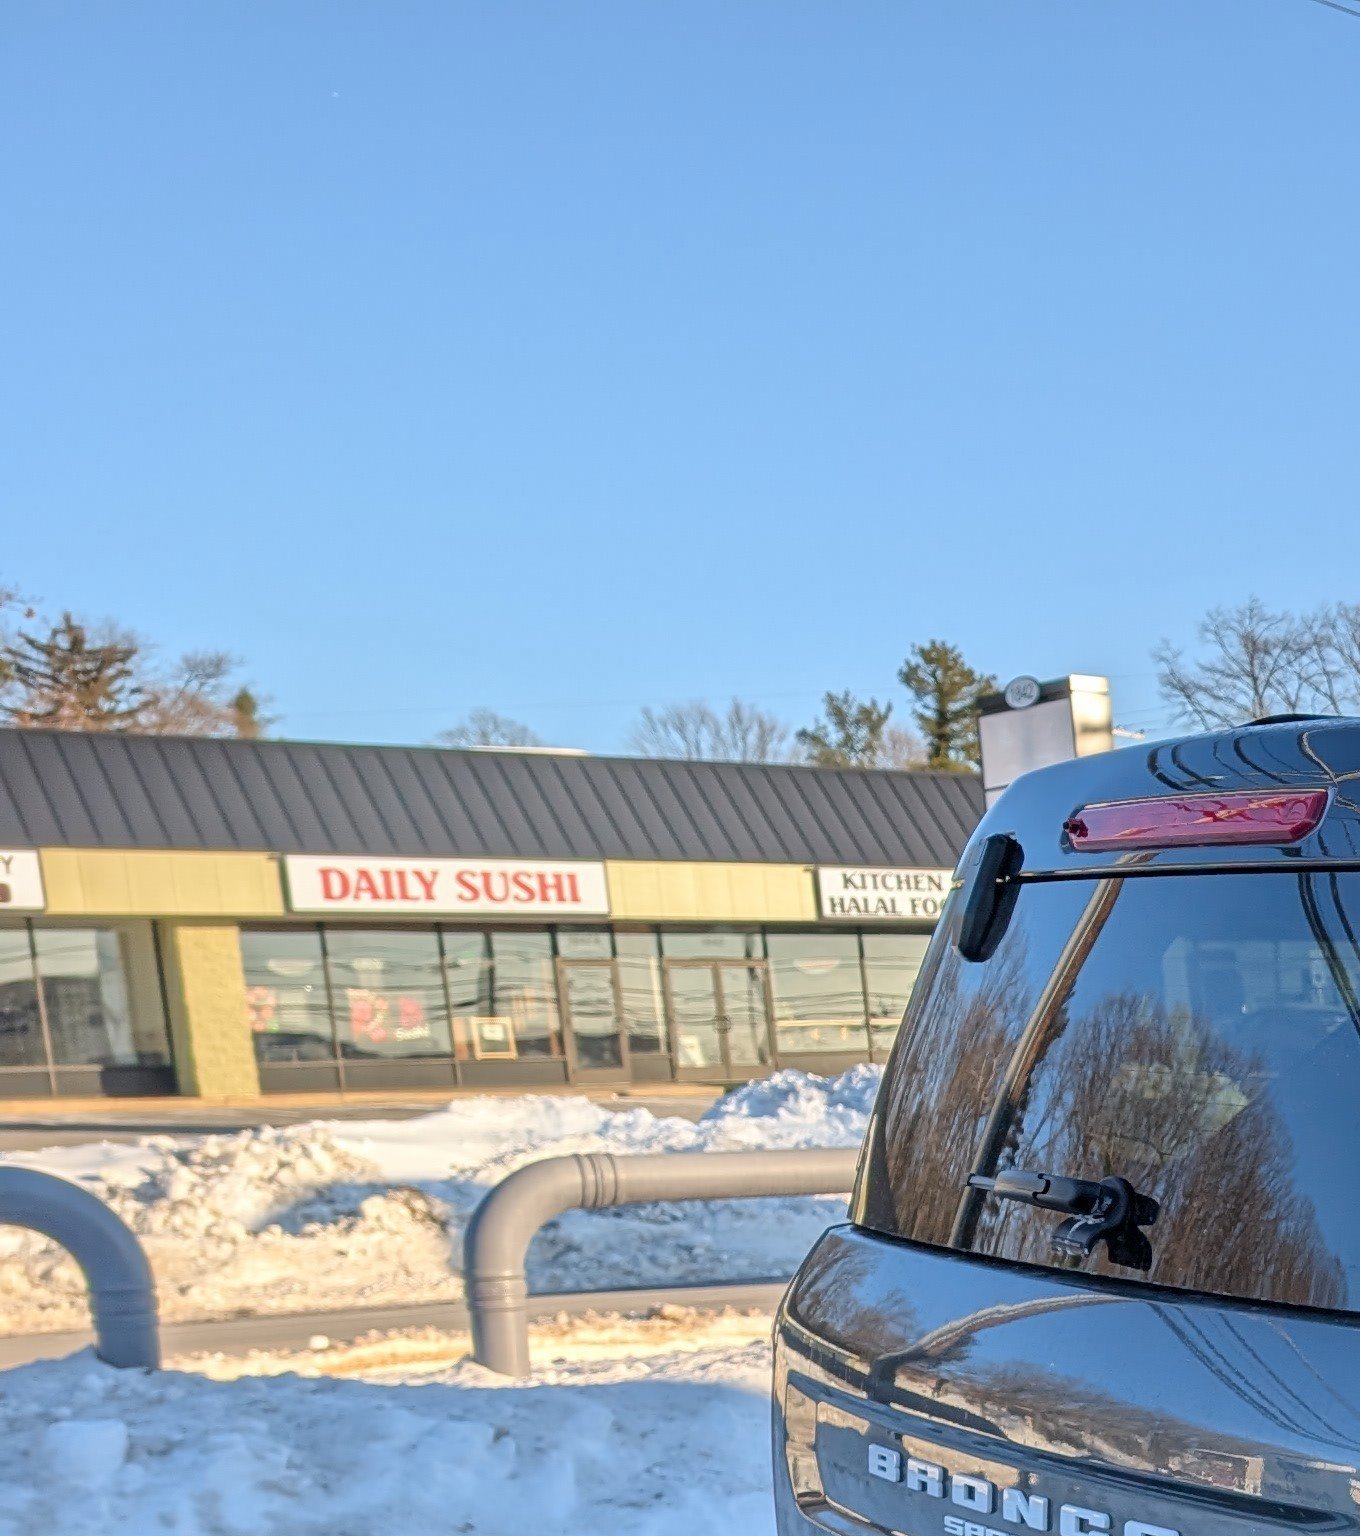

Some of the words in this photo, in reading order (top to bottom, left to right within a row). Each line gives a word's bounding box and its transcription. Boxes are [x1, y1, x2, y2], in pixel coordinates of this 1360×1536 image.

[318, 867, 439, 901] DAILY
[454, 870, 582, 904] SUSHI
[842, 873, 944, 892] KITCHEN
[829, 897, 901, 914] HALAL
[910, 897, 946, 915] FO
